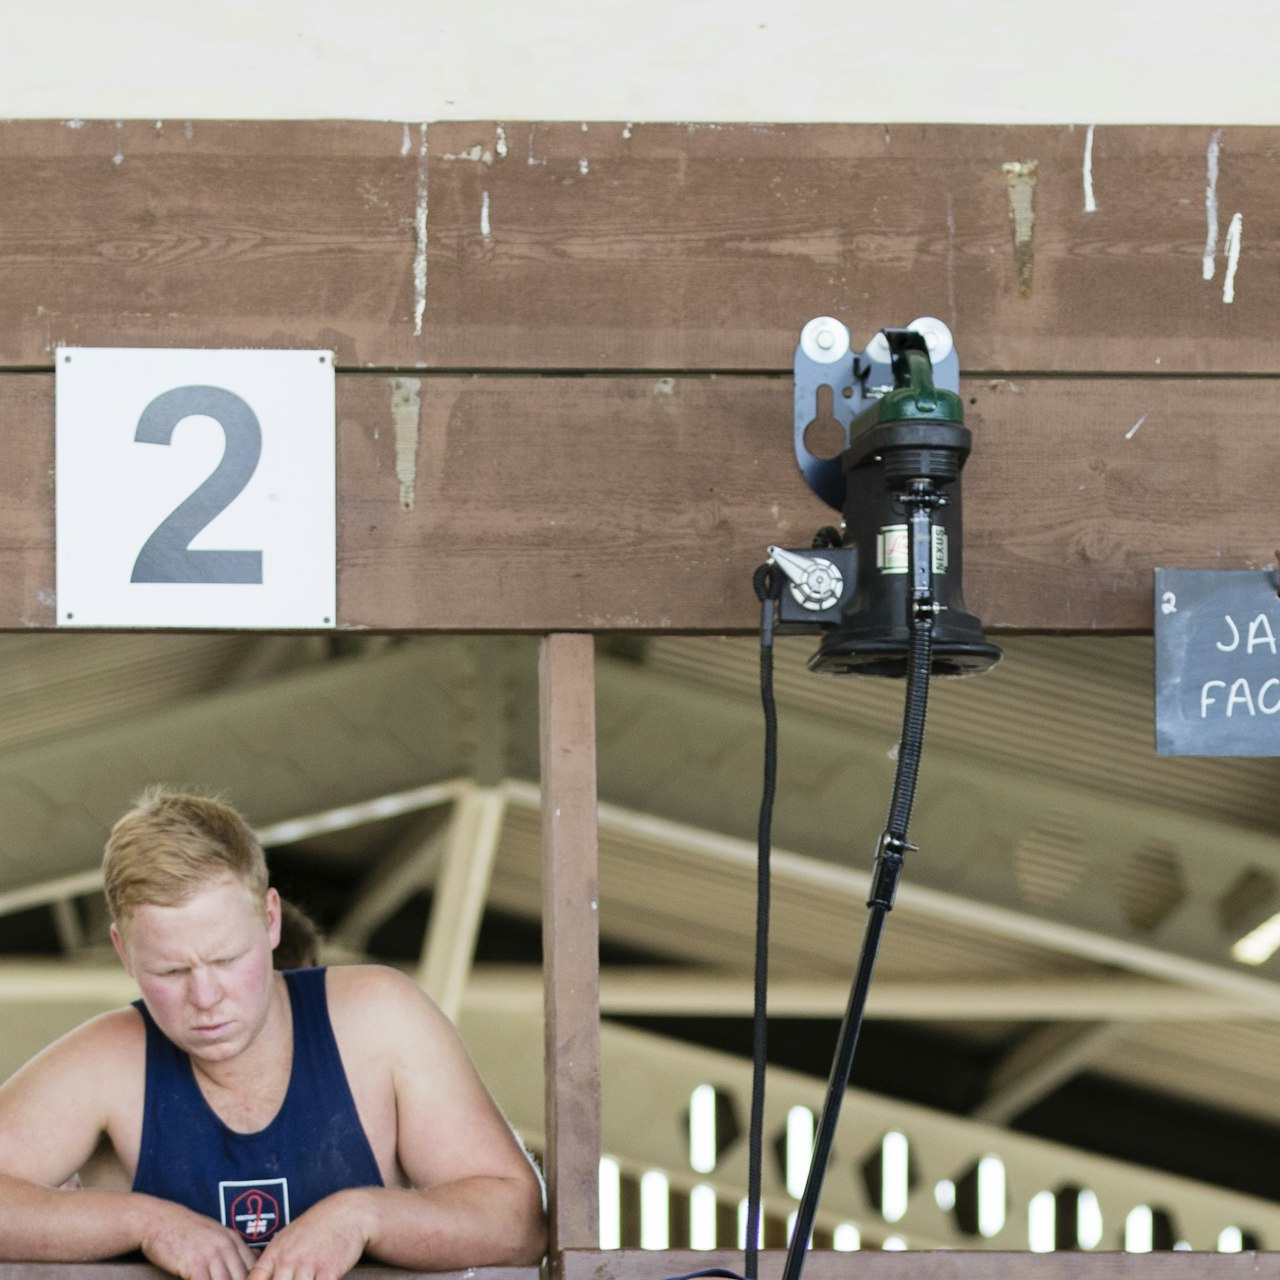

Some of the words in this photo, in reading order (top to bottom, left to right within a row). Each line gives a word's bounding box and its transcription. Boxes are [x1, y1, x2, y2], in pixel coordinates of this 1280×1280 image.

[129, 384, 263, 585] 2
[935, 529, 946, 571] NEXUS
[1161, 591, 1178, 615] 2
